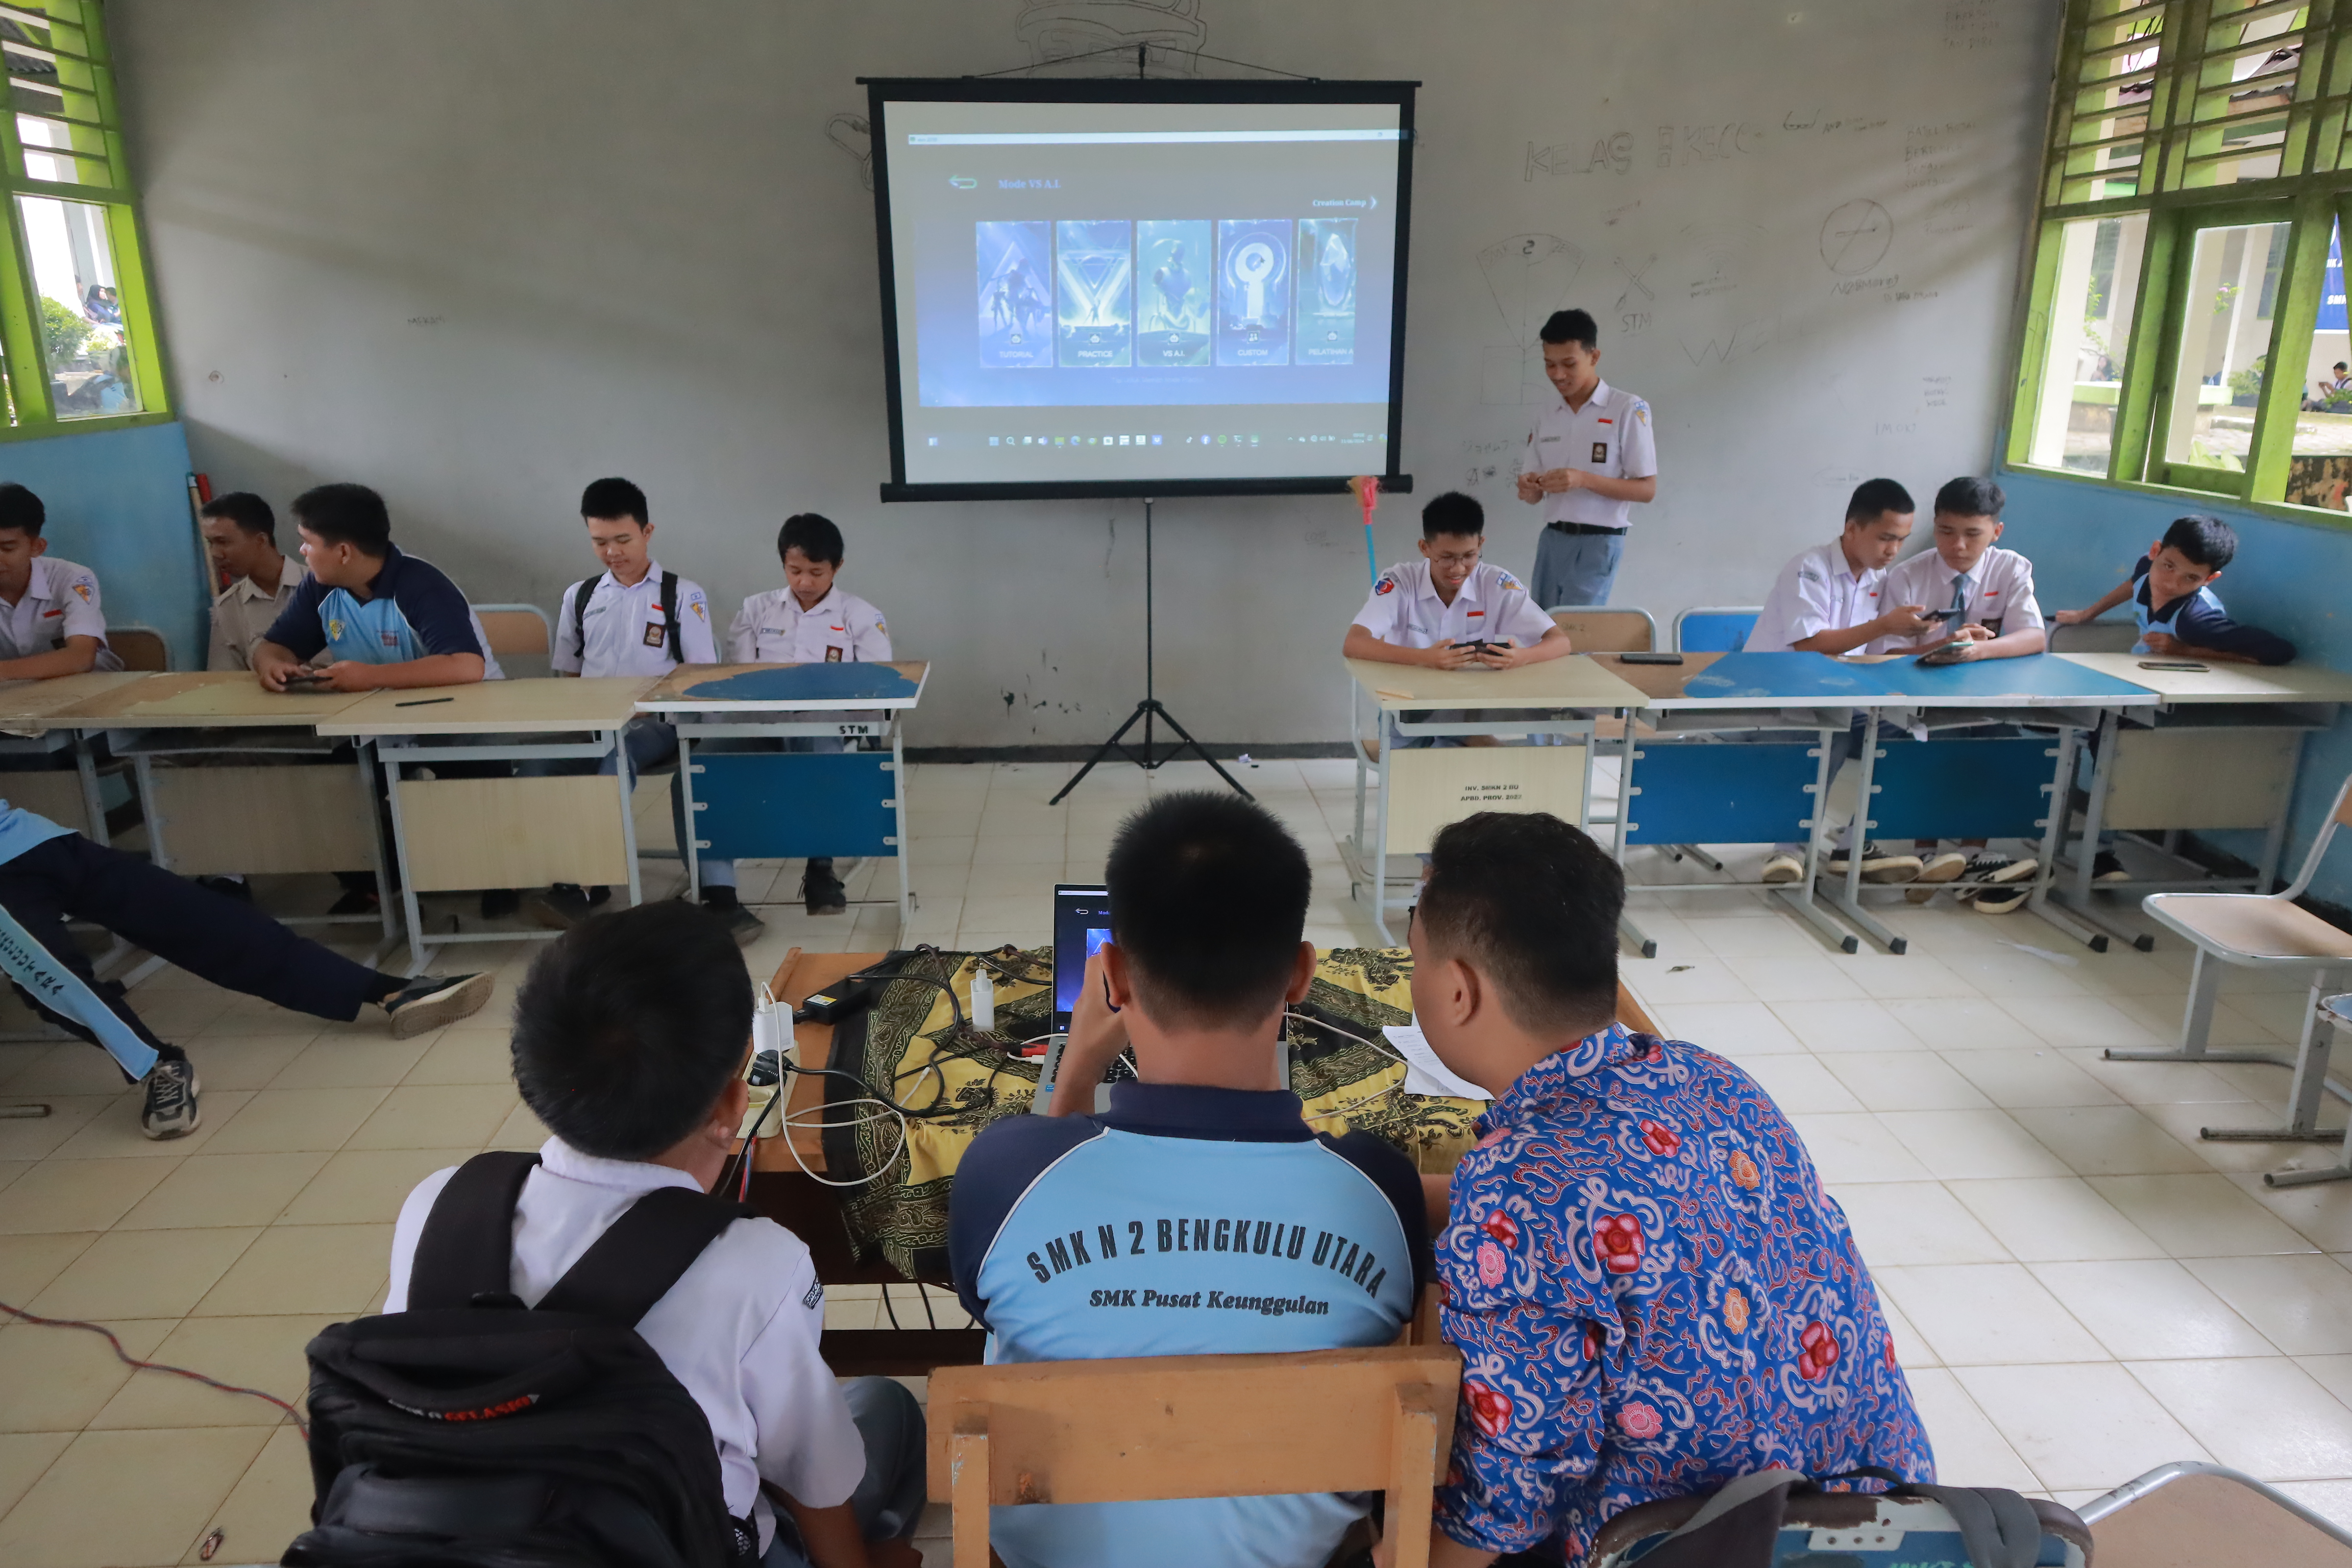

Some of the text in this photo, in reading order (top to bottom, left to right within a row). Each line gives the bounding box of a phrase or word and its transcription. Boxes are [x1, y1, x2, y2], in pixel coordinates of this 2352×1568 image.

[1524, 131, 1634, 182] KELAS
[999, 179, 1061, 189] Mode VS A.I.
[1345, 199, 1367, 207] Camp
[1621, 312, 1652, 333] STM
[839, 725, 868, 734] STM
[1026, 1219, 1387, 1299] SMK N 2 BENGKULU UTARA
[1090, 1290, 1329, 1316] SMK Pusat Keunggulan
